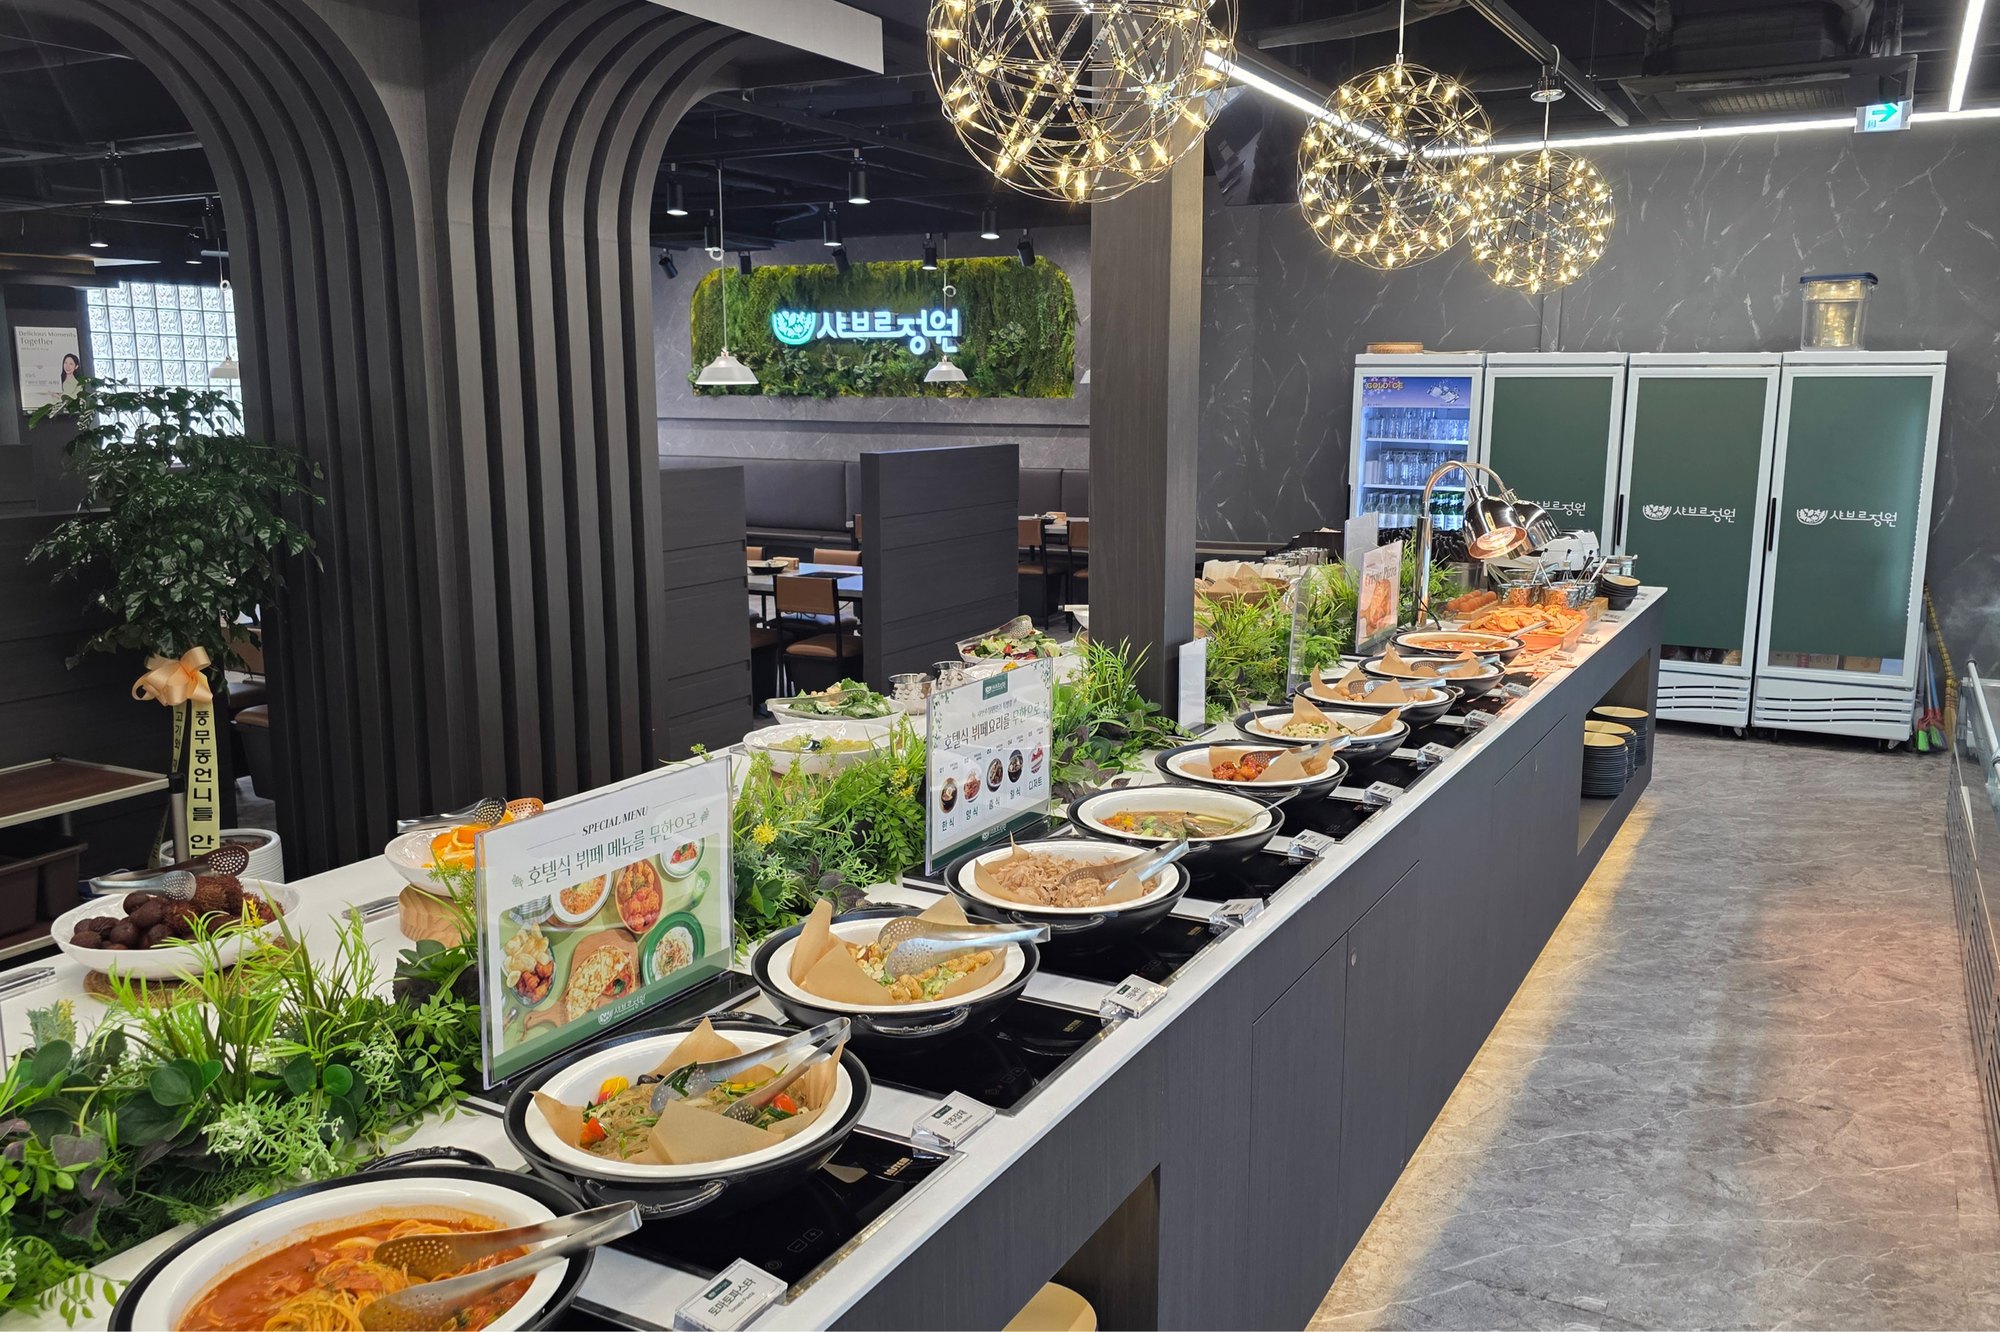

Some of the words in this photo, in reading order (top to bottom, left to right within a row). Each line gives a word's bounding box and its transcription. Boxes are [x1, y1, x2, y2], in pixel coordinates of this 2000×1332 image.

[20, 337, 53, 346] Together
[816, 308, 959, 355] 샤브르정원
[1673, 506, 1736, 523] 샤브르정원
[1829, 510, 1897, 528] 샤브르정원
[1383, 565, 1397, 579] Pizza
[944, 728, 969, 751] 호텔식
[972, 713, 1010, 740] 뷔페요리를
[1012, 703, 1040, 726] 무한으로
[193, 710, 213, 821] 풍무동언니들
[1028, 777, 1042, 790] 디저트
[582, 816, 621, 836] SPECIAL
[622, 806, 649, 824] MENU
[942, 817, 955, 832] 한식
[527, 854, 572, 887] 호텔식
[576, 843, 604, 871] 뷔페
[607, 829, 645, 858] 메뉴를
[650, 812, 698, 844] 무한으로
[708, 1277, 756, 1317] 토마토파스타
